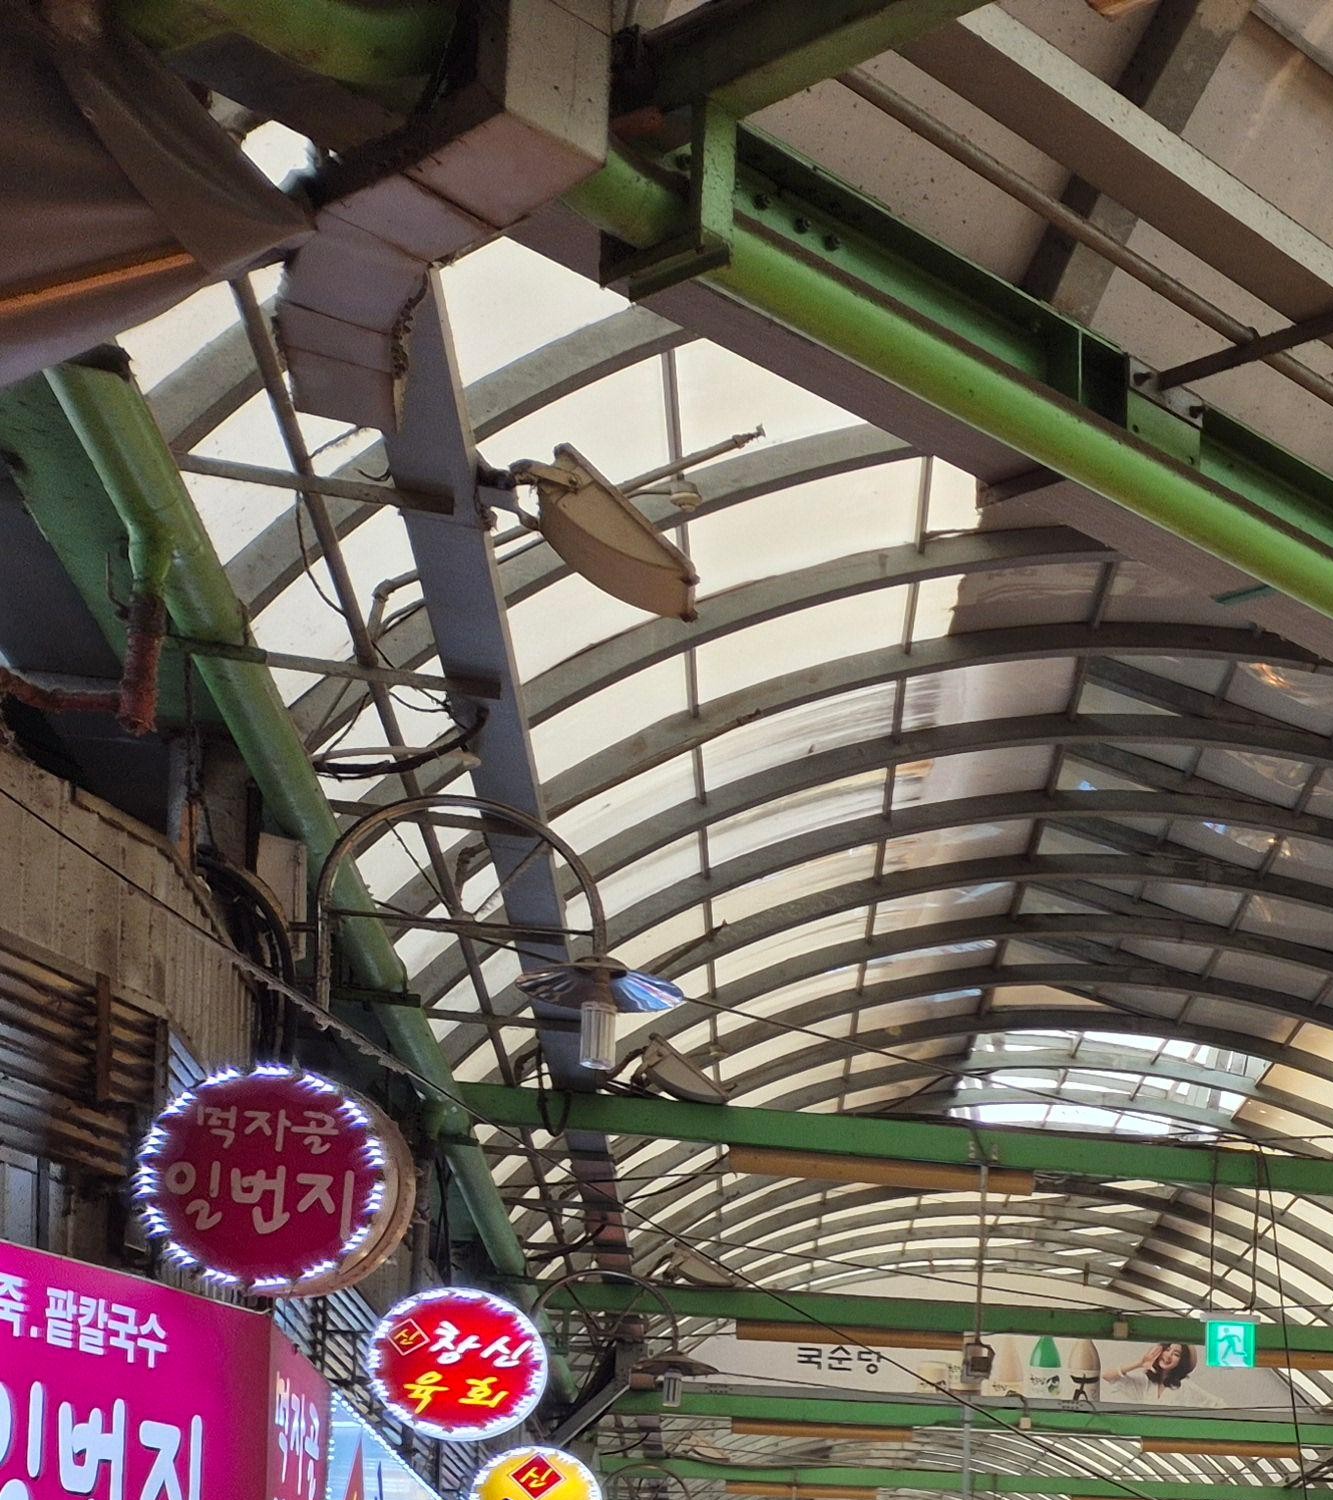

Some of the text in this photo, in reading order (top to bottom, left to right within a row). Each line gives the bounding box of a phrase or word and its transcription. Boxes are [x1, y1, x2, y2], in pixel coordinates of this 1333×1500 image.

[197, 1105, 340, 1155] 먹자골
[164, 1160, 356, 1241] 일번지
[428, 1320, 533, 1368] 창신
[797, 1345, 882, 1375] 국순당
[404, 1371, 509, 1414] 육회
